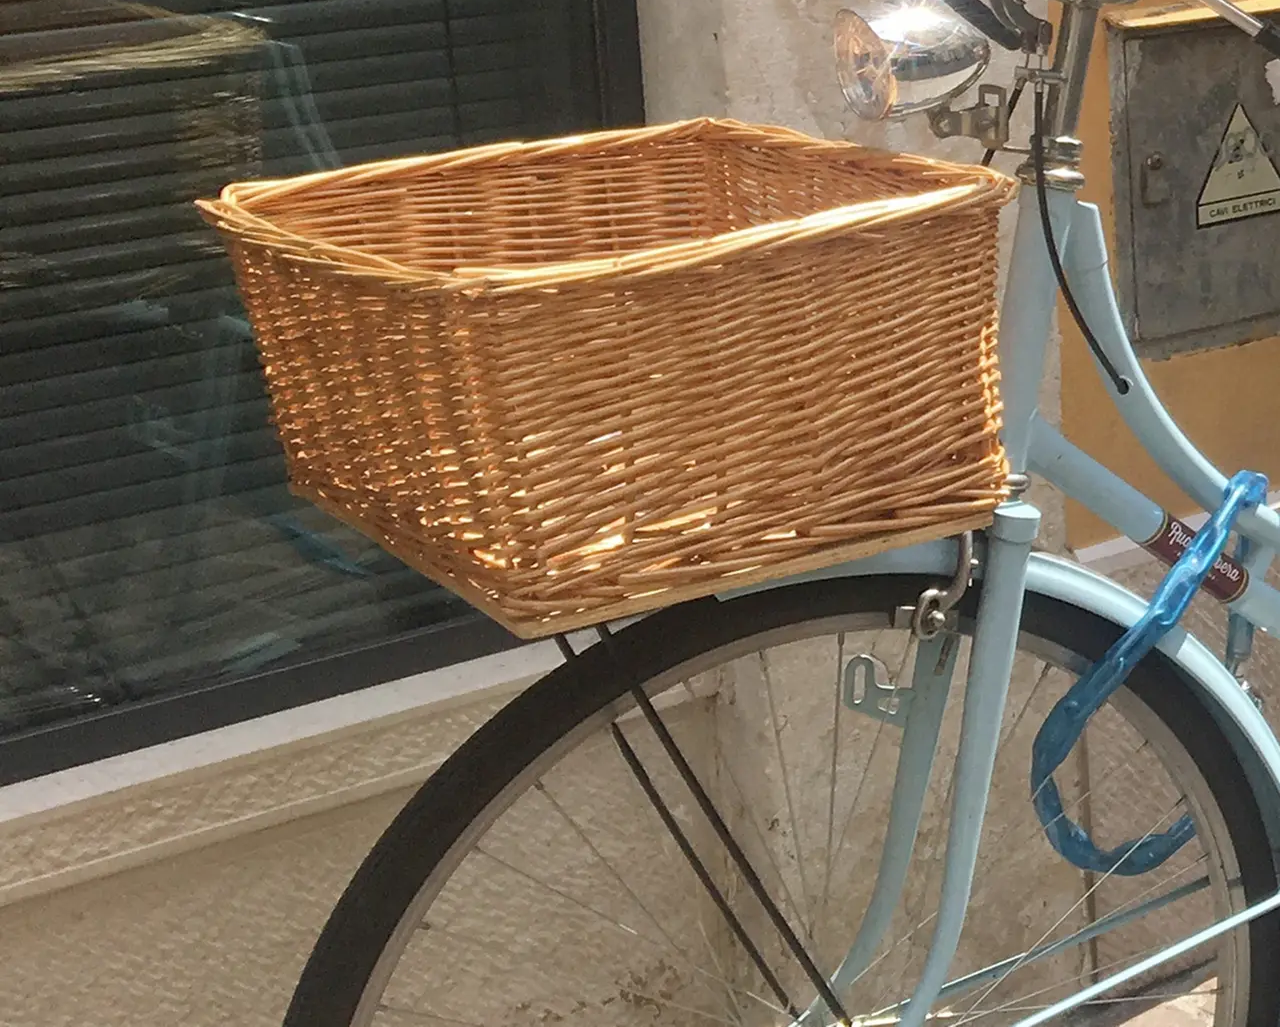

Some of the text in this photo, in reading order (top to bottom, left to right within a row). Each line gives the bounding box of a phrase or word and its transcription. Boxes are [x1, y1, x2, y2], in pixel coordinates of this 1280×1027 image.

[1209, 197, 1276, 218] CAVI ELETTRICI
[1168, 521, 1241, 582] Ruo bera
